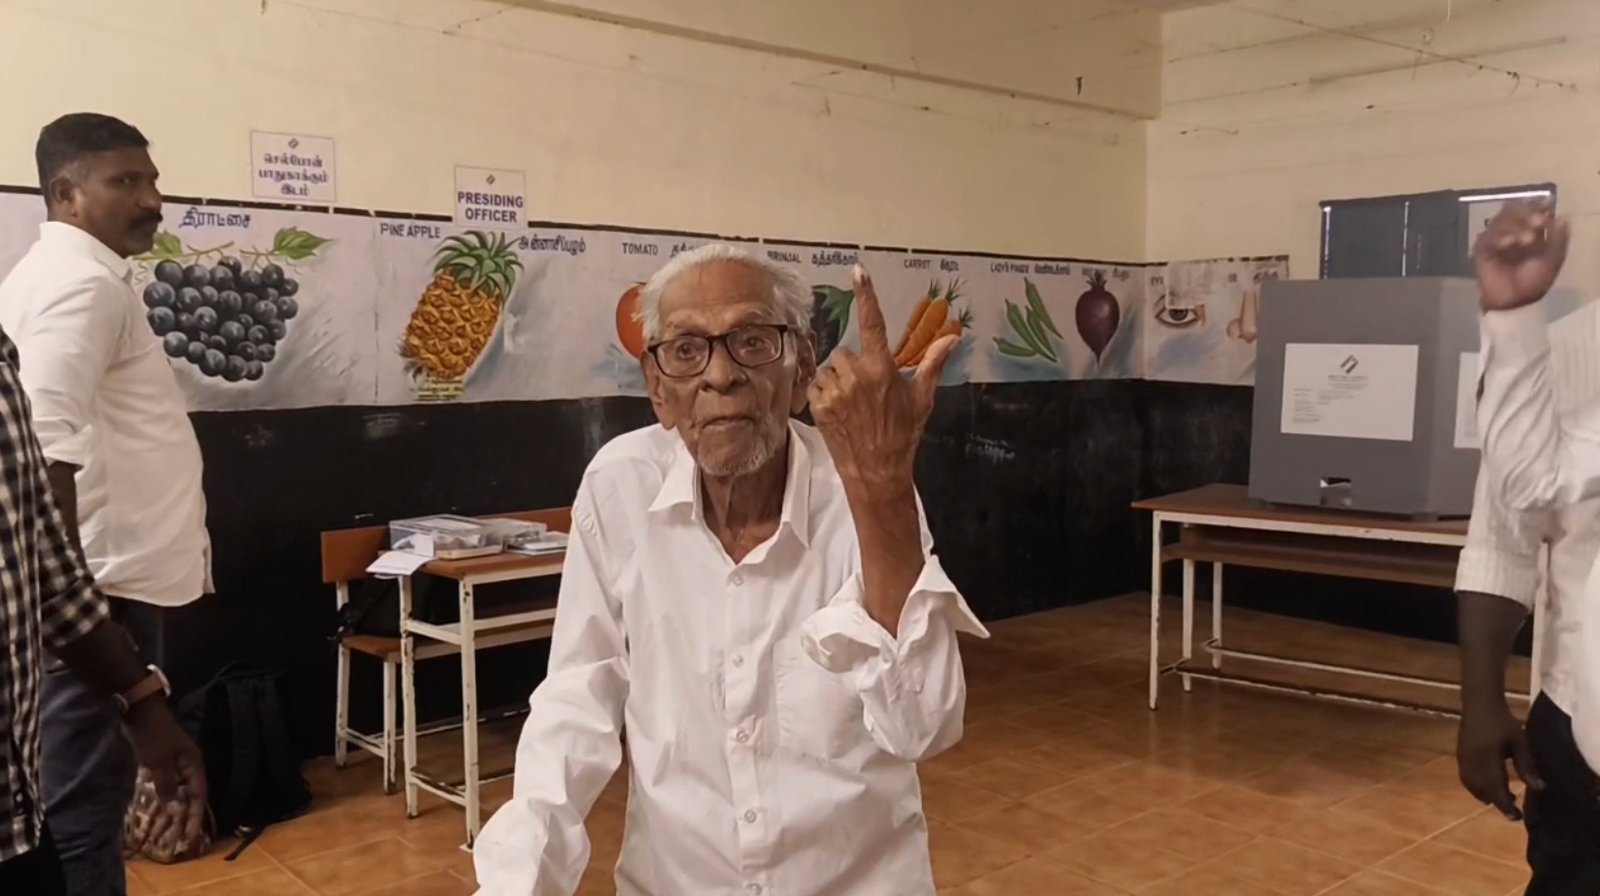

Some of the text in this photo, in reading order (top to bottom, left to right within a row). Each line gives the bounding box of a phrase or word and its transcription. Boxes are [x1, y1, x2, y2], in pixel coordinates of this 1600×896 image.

[258, 169, 329, 183] பாதுகாக்கும்
[280, 183, 310, 196] இடம்
[457, 191, 524, 208] PRESIDING
[465, 207, 518, 223] OFFICER
[622, 242, 659, 256] TOMATO
